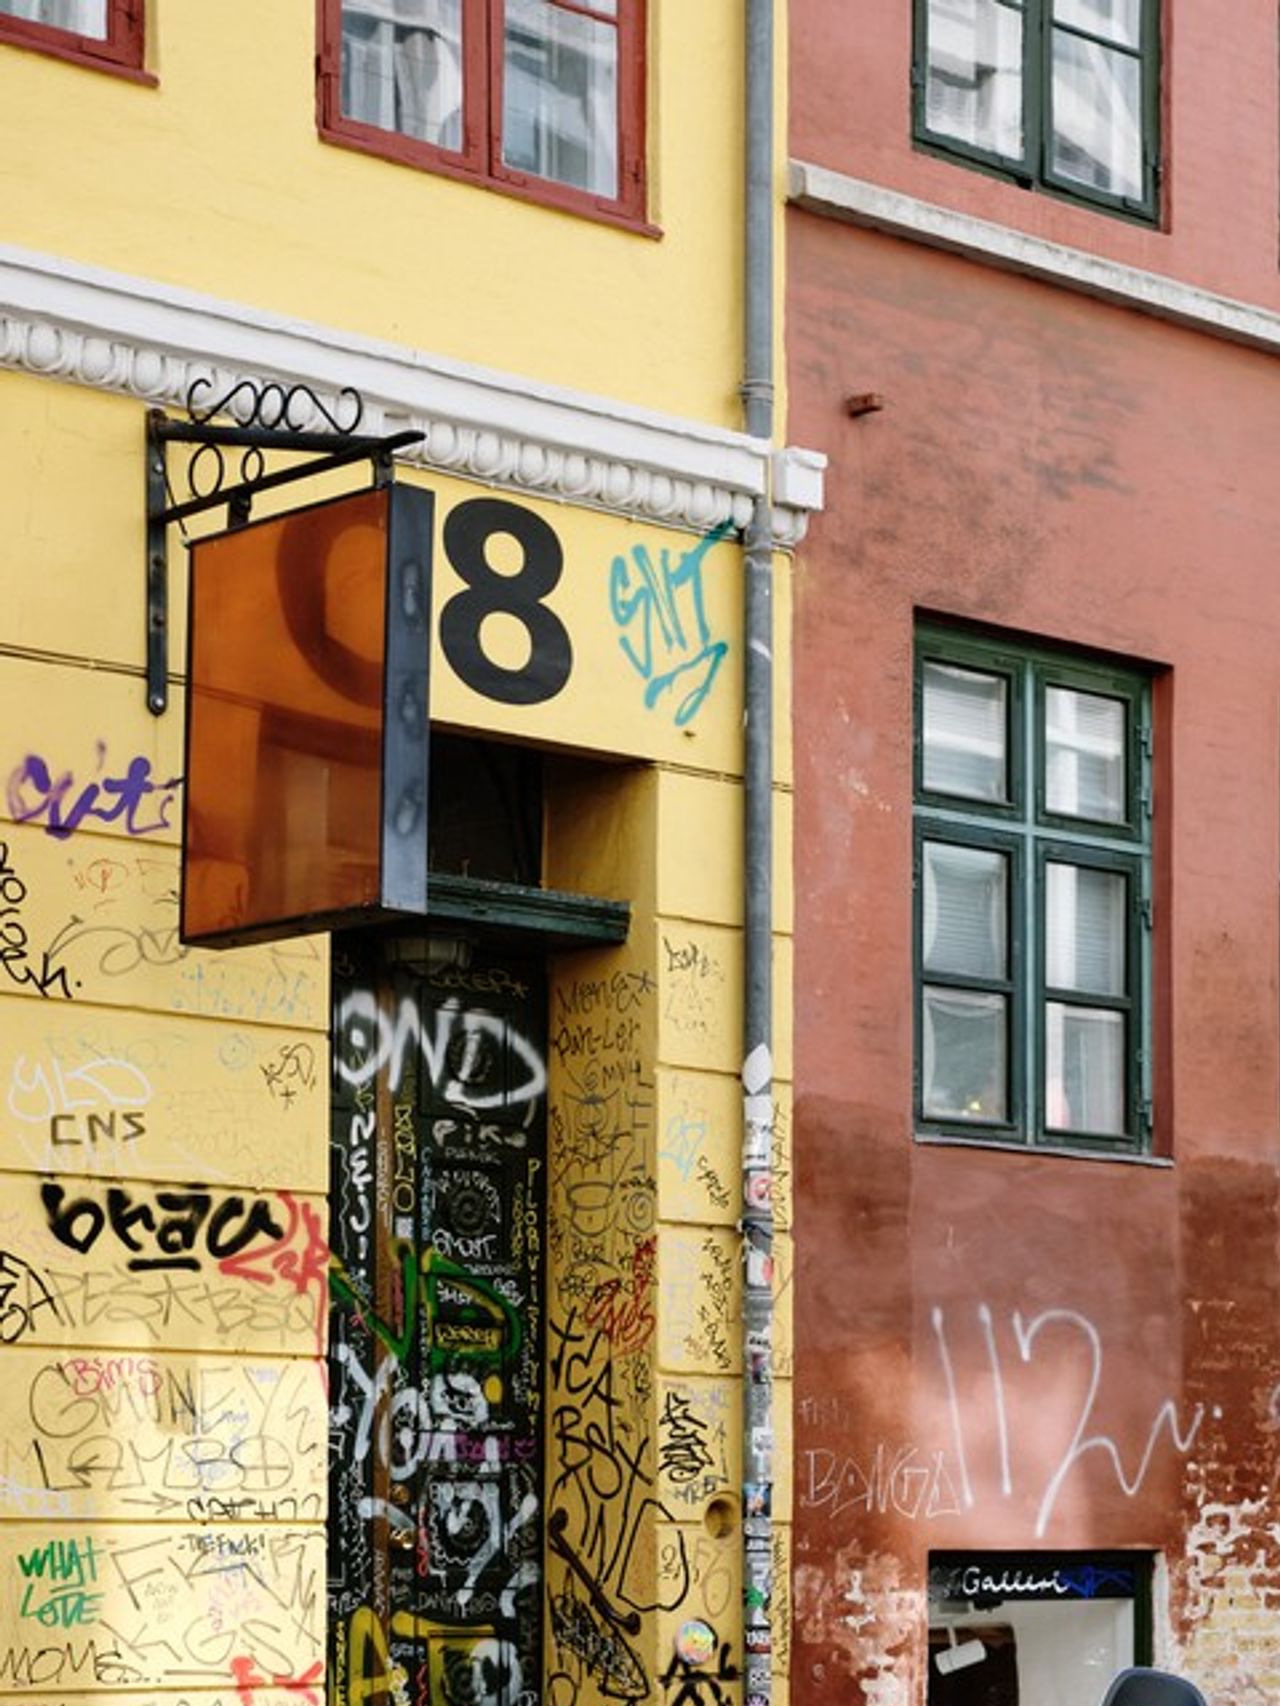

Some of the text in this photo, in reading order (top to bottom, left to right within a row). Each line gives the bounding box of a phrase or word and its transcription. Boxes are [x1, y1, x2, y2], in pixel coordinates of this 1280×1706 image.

[439, 497, 573, 706] 8
[51, 1112, 146, 1145] CNS
[962, 1567, 1071, 1595] Galleri
